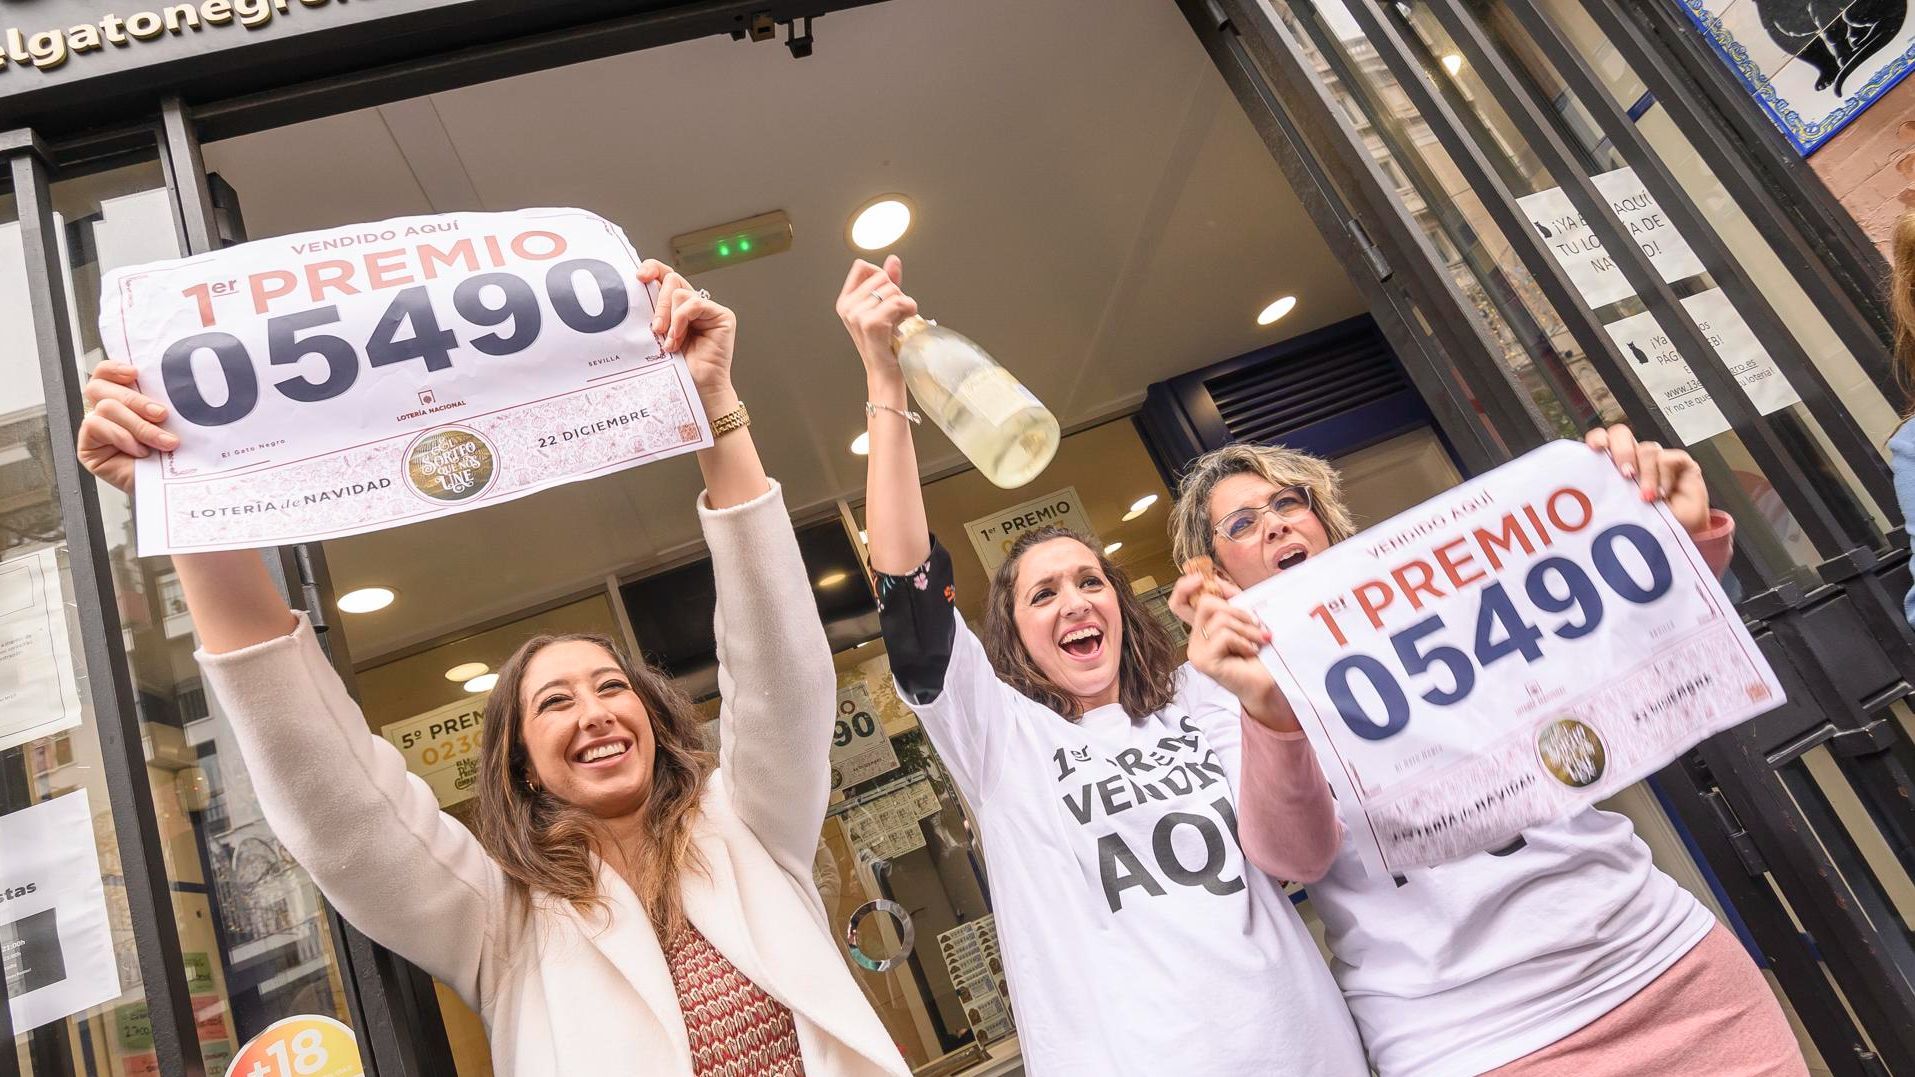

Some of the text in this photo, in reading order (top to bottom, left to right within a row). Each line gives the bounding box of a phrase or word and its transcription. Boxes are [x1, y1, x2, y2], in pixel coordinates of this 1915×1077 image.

[1613, 190, 1653, 215] AQUÍ
[291, 219, 460, 256] VENDIDO AQUÍ
[1556, 241, 1580, 256] TU
[1641, 214, 1666, 231] DE
[182, 230, 568, 329] 1er PREMIO
[160, 257, 630, 427] 05490
[587, 353, 621, 368] SEVILLA
[396, 400, 467, 423] LOTERÍA NACIONAL
[538, 407, 650, 448] 22 DICIEMBRE
[190, 500, 277, 519] LOTERÍA
[303, 477, 392, 506] NAVIDAD
[1001, 501, 1071, 535] PREMIO
[1366, 514, 1447, 560] VENDIDO
[1351, 486, 1593, 632] PREMIO
[1324, 522, 1674, 741] 05490
